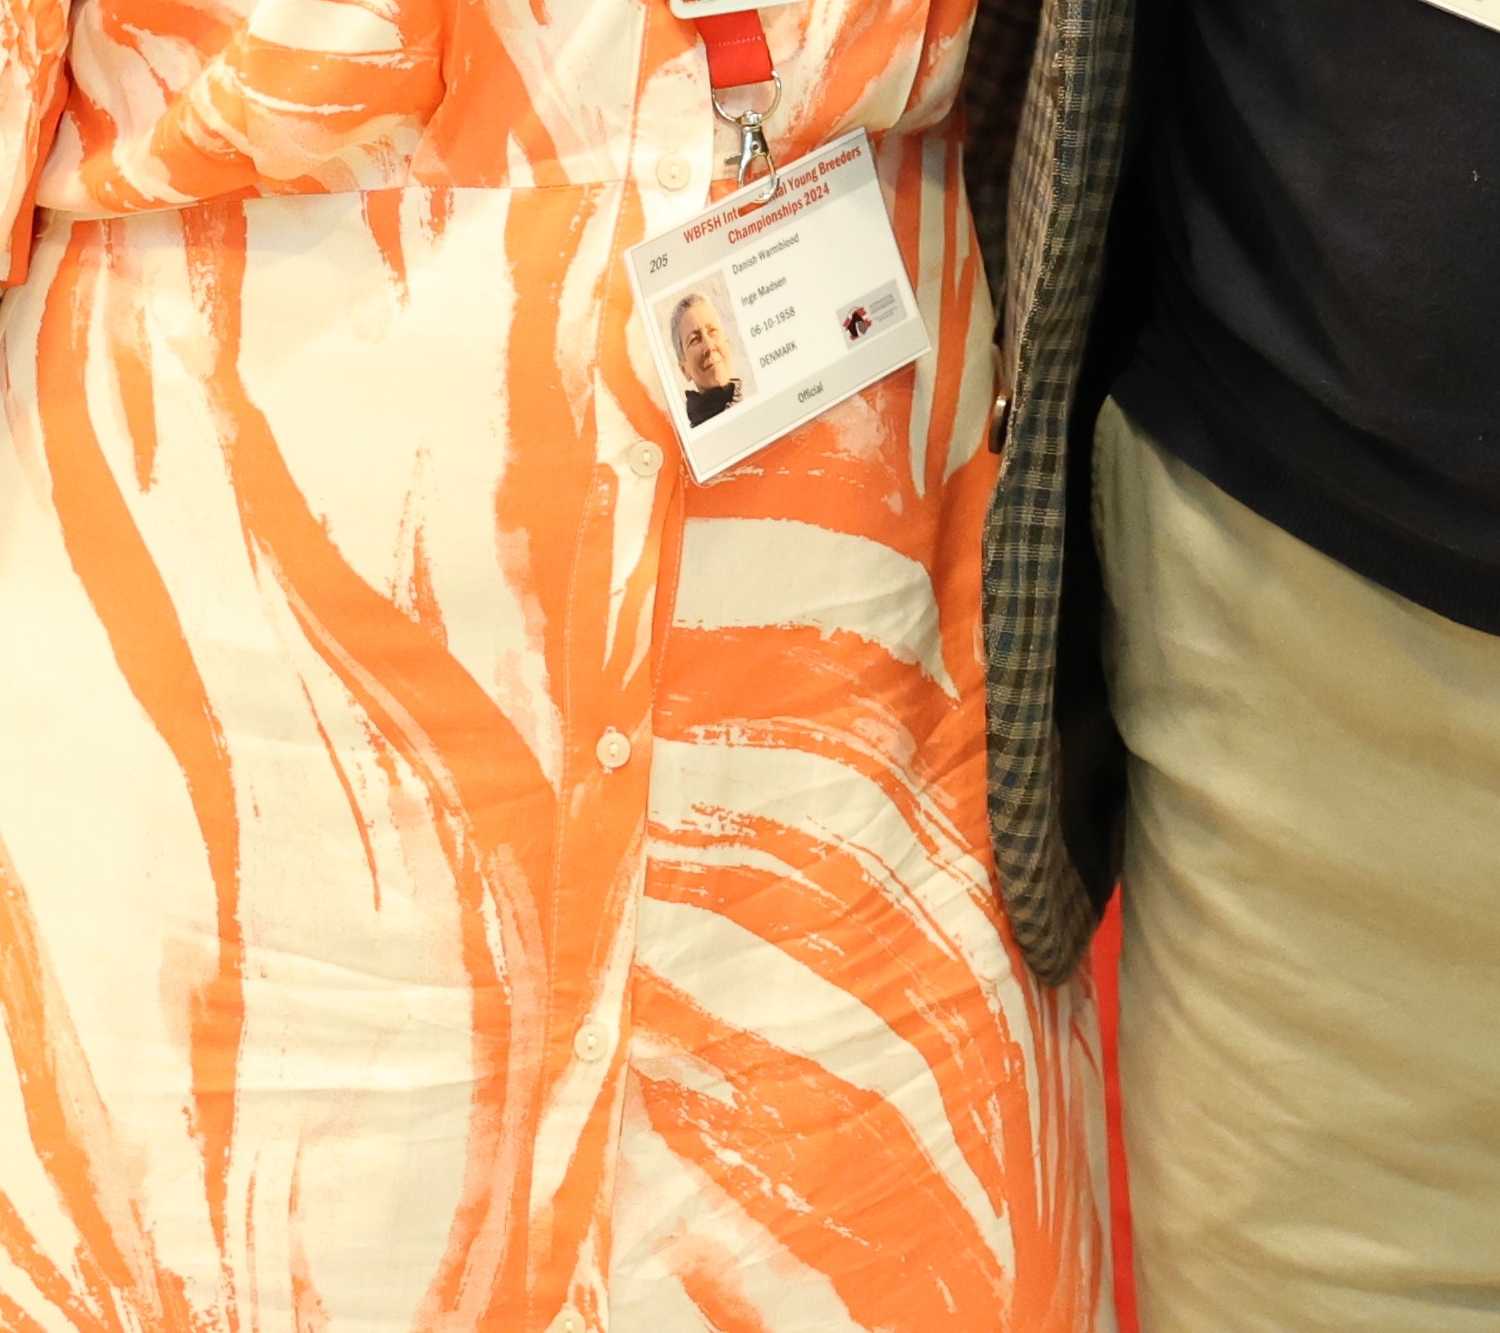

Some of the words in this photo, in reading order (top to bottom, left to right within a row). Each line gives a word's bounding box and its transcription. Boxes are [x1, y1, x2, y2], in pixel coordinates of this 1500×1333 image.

[683, 214, 722, 244] WBFSH
[787, 167, 819, 194] Young
[819, 146, 862, 176] Breeders
[728, 198, 804, 244] Championships
[803, 182, 830, 206] 2024
[650, 253, 669, 274] 205
[731, 256, 758, 275] Danish
[758, 233, 800, 261] Warmblood
[740, 292, 758, 307] Inge
[757, 276, 788, 298] Madsen
[750, 306, 797, 338] 06-10-1958
[759, 340, 799, 368] DENMARK
[797, 382, 824, 403] Official
